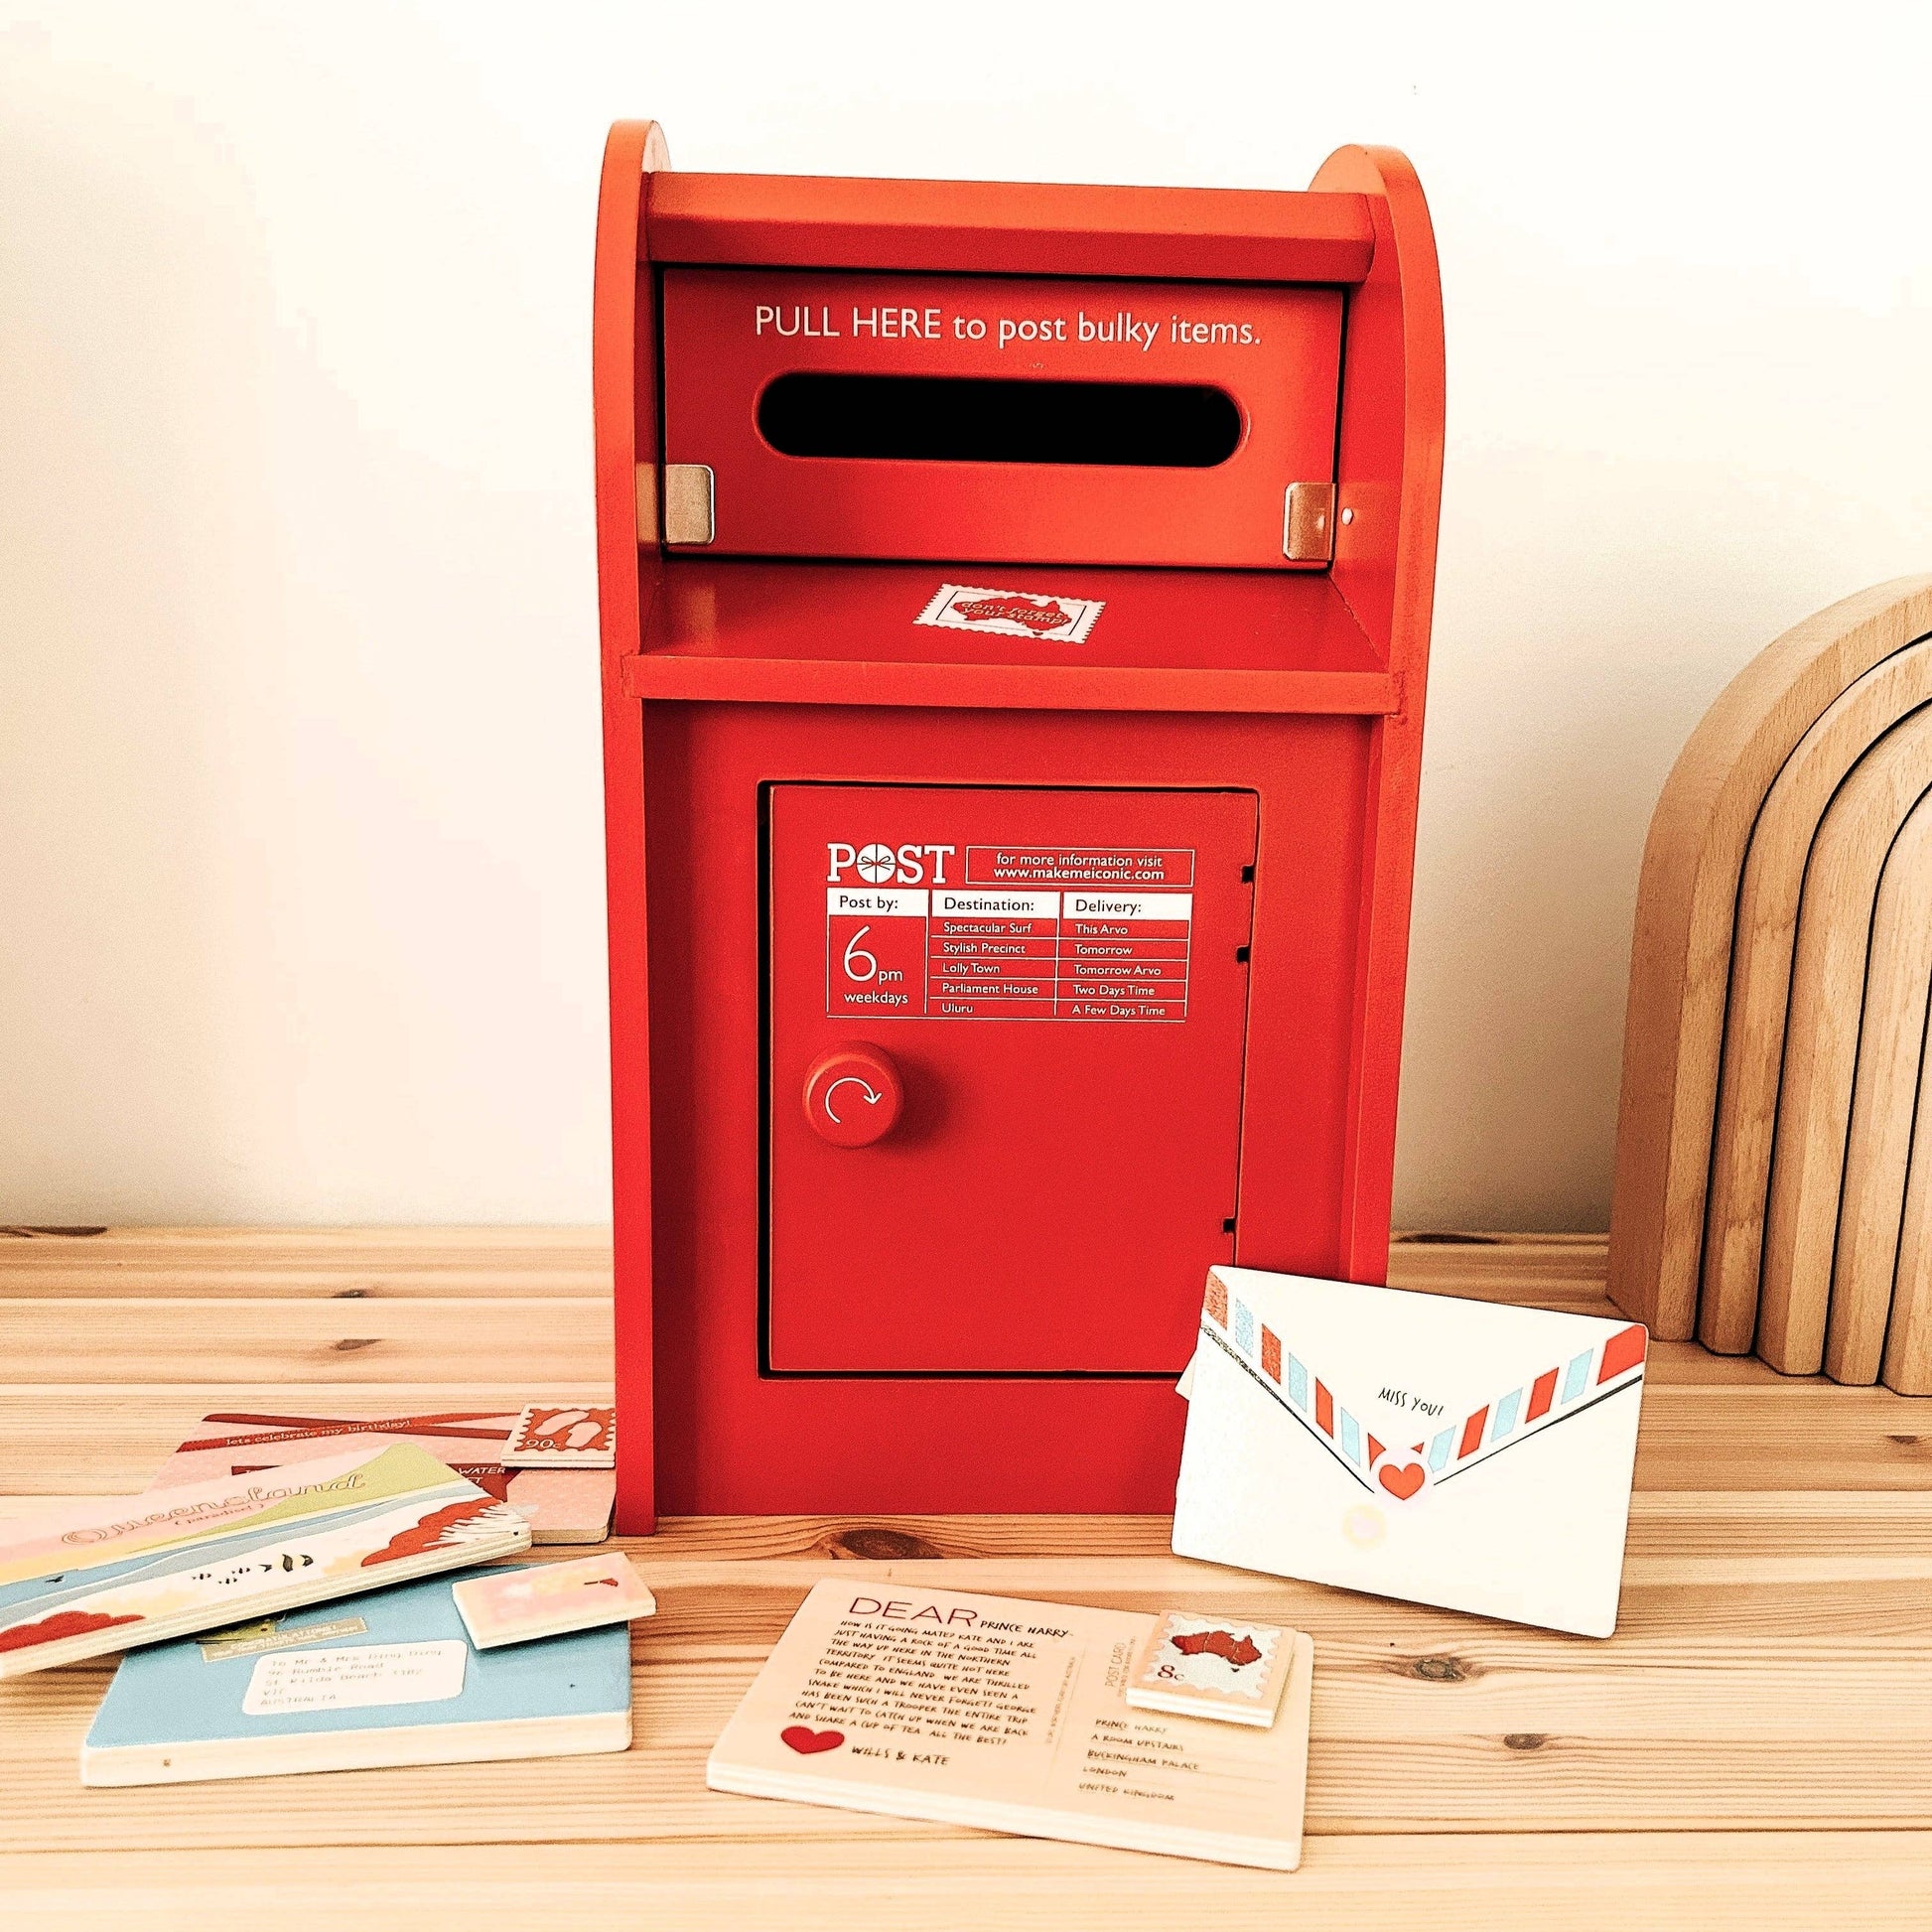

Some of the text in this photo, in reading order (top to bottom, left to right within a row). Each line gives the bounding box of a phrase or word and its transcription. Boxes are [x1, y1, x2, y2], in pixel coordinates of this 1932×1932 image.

[756, 306, 1262, 351] PULL HERE to post bulky items.
[960, 608, 1005, 617] your
[961, 602, 1063, 620] don't forget
[827, 843, 955, 885] POST
[996, 852, 1163, 867] for more information visit
[994, 866, 1165, 881] www.makemeiconic.com
[839, 895, 898, 912] Post by:
[944, 897, 1035, 911] Destination:
[1075, 898, 1142, 916] Delivery:
[943, 921, 1033, 934] Spectacular Surf
[1075, 923, 1129, 934] This Arvo
[943, 942, 1026, 955] Stylish Precinct
[1074, 944, 1133, 955] Tomorrow
[942, 963, 1001, 975] Lolly Town
[1073, 964, 1162, 975] Tomorrow Arvo
[942, 983, 1038, 994] Parliament House
[1073, 985, 1155, 998] Two Days Time
[844, 991, 908, 1007] weekdays
[941, 1003, 974, 1013] Uluru
[1071, 1005, 1166, 1018] A Few Days Time
[1378, 1387, 1445, 1416] MISS YOU!
[225, 1420, 411, 1447] lets celebrate my birthday!
[525, 1439, 562, 1449] 90c
[849, 1596, 978, 1627] DEAR
[980, 1619, 1024, 1633] PRINCE
[889, 1625, 918, 1635] GOING
[860, 1632, 897, 1642] HAVING
[995, 1647, 1015, 1656] TIME
[826, 1648, 876, 1660] TERRITORY
[897, 1656, 926, 1667] SEEMS
[985, 1668, 1011, 1677] HERE
[936, 1650, 954, 1659] THE
[958, 1654, 1011, 1666] NORTHERN
[819, 1658, 869, 1669] COMPARED
[889, 1668, 935, 1678] ENGLAND
[986, 1678, 1031, 1690] THRILLED
[808, 1679, 840, 1688] SNAKE
[909, 1692, 945, 1702] NEVER
[996, 1703, 1037, 1714] GEORGE
[917, 1682, 946, 1691] HAVE
[950, 1686, 979, 1695] EVEN
[983, 1689, 1008, 1699] SEEN
[823, 1692, 852, 1702] BEEN
[855, 1696, 879, 1706] SUCH
[895, 1701, 937, 1713] TROOPER
[942, 1707, 962, 1716] THE
[965, 1711, 1001, 1721] ENTIRE
[1007, 1715, 1028, 1724] TRIP
[795, 1700, 828, 1710] CAN'T
[875, 1710, 905, 1722] CATCH
[1004, 1727, 1029, 1736] BACK
[814, 1714, 847, 1725] SHARE
[861, 1720, 880, 1728] CUP
[902, 1725, 920, 1734] TEA
[953, 1731, 973, 1740] THE
[1102, 1734, 1133, 1744] ROOM
[1137, 1739, 1183, 1751] UPSTAIRS
[851, 1745, 950, 1765] WILLS & KATE
[1087, 1749, 1199, 1770] BUCKINGHAM PALACE
[1082, 1766, 1128, 1777] LONDON
[1078, 1782, 1119, 1793] UNITED
